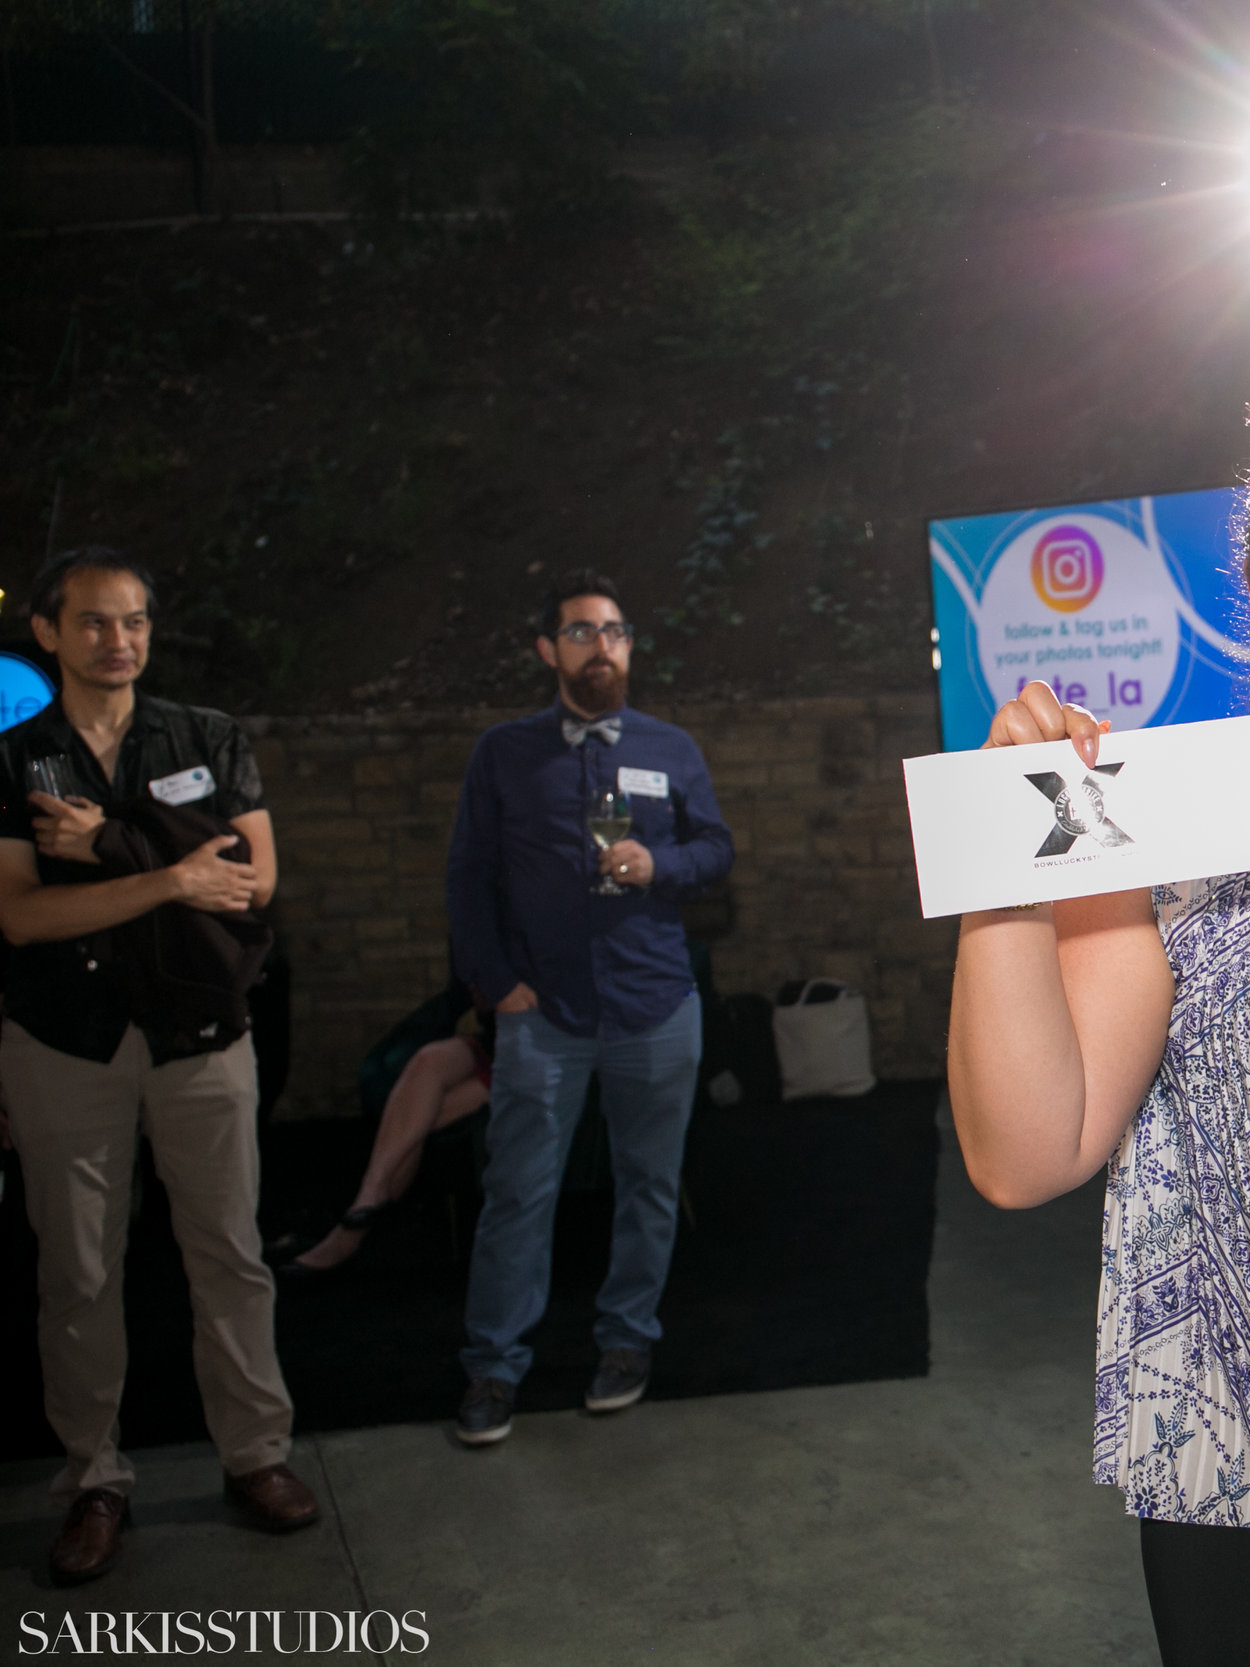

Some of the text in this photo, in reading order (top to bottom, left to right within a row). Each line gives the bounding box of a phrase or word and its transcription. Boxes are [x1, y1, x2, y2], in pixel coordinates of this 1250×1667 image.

[1004, 614, 1148, 640] follow & tag us in
[994, 653, 1030, 668] your
[1035, 645, 1092, 665] photos
